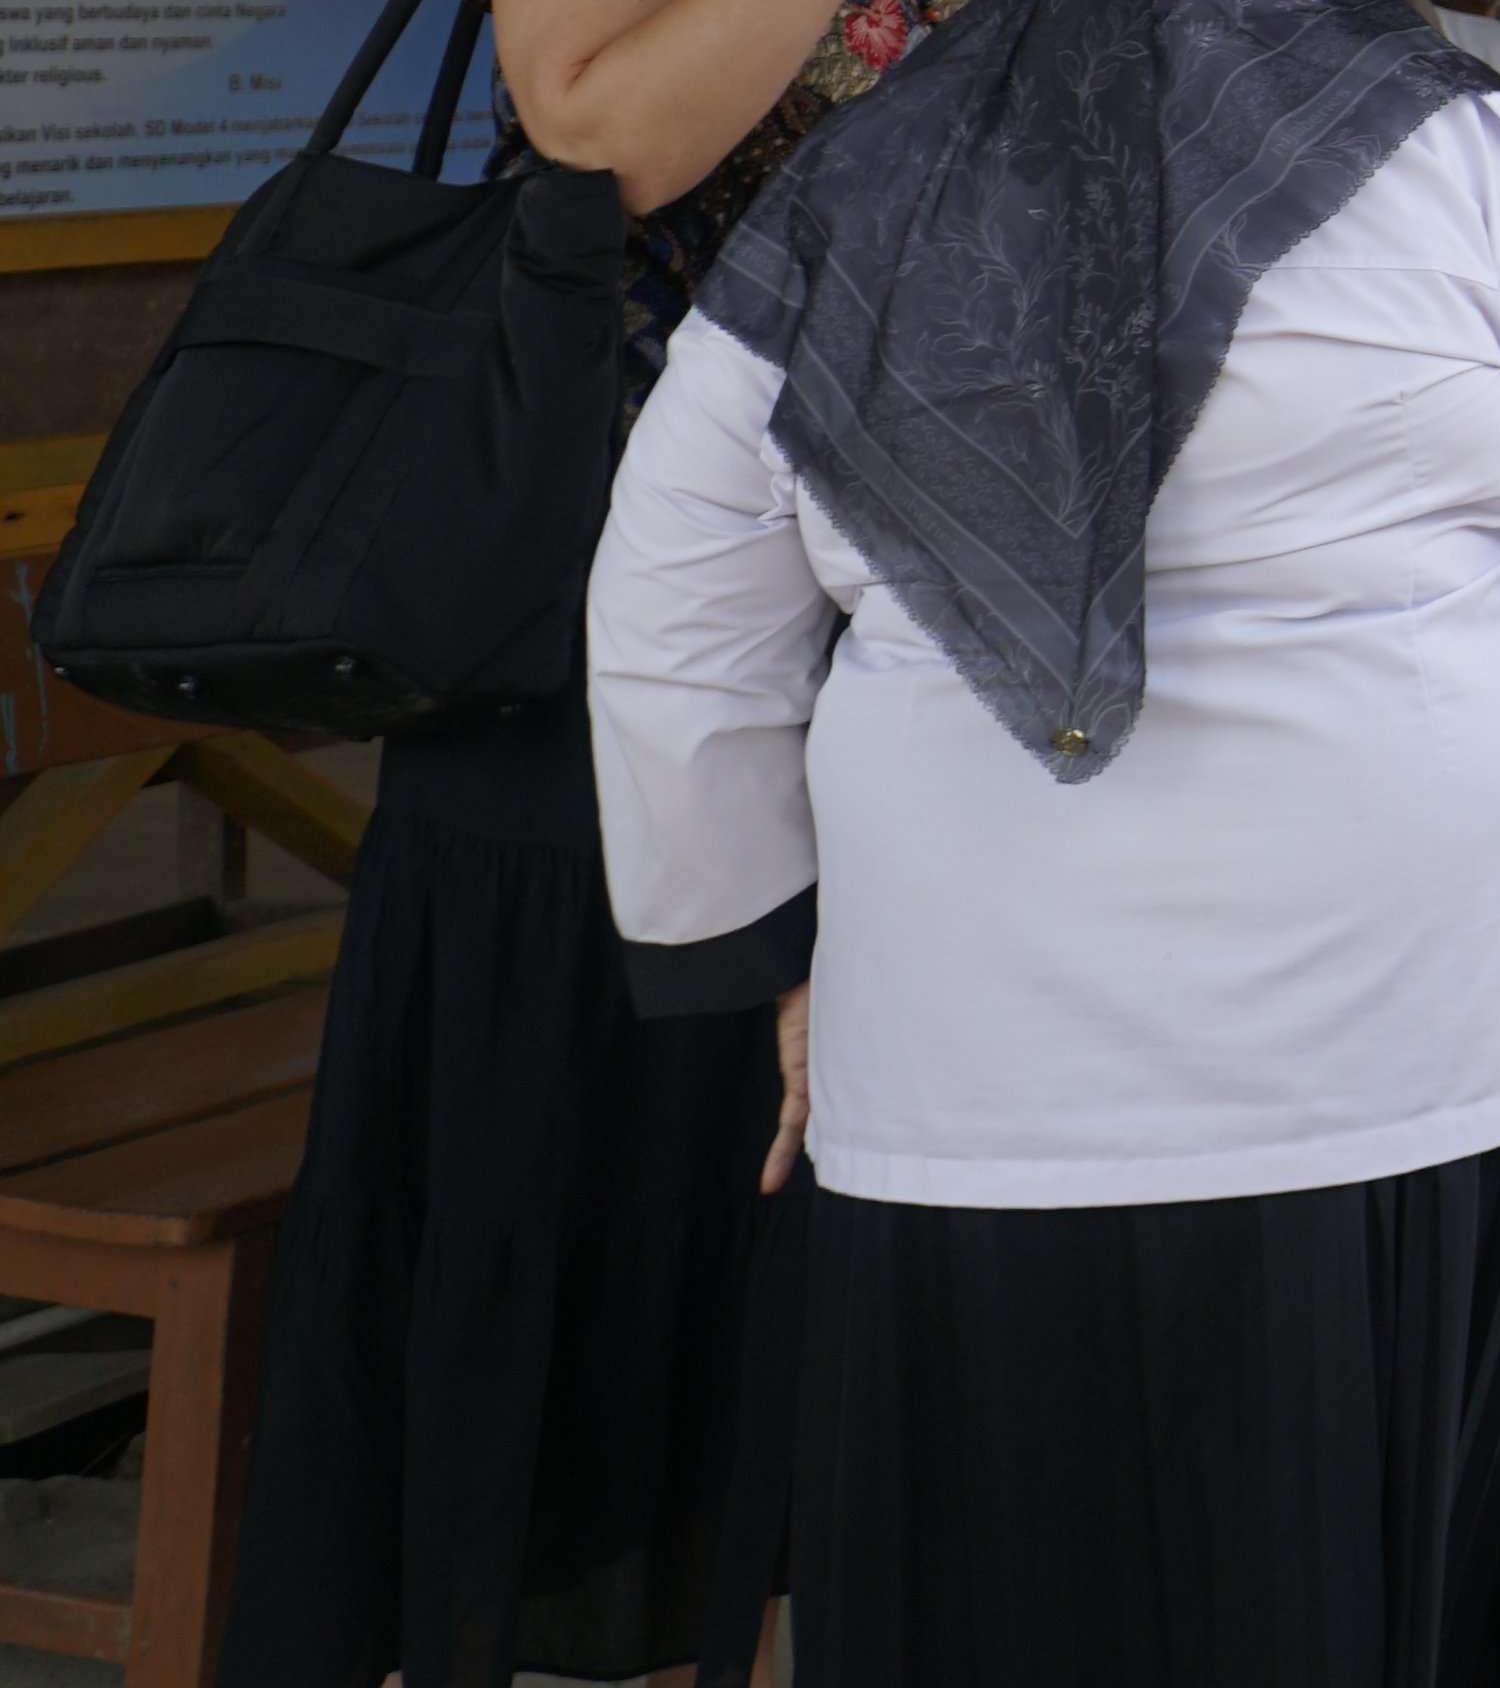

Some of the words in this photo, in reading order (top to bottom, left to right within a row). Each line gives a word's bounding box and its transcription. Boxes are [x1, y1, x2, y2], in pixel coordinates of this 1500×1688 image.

[35, 6, 74, 27] yang
[163, 3, 192, 19] dan
[72, 37, 115, 51] aman
[118, 34, 148, 50] dan
[144, 119, 166, 137] SD
[84, 151, 114, 170] dan
